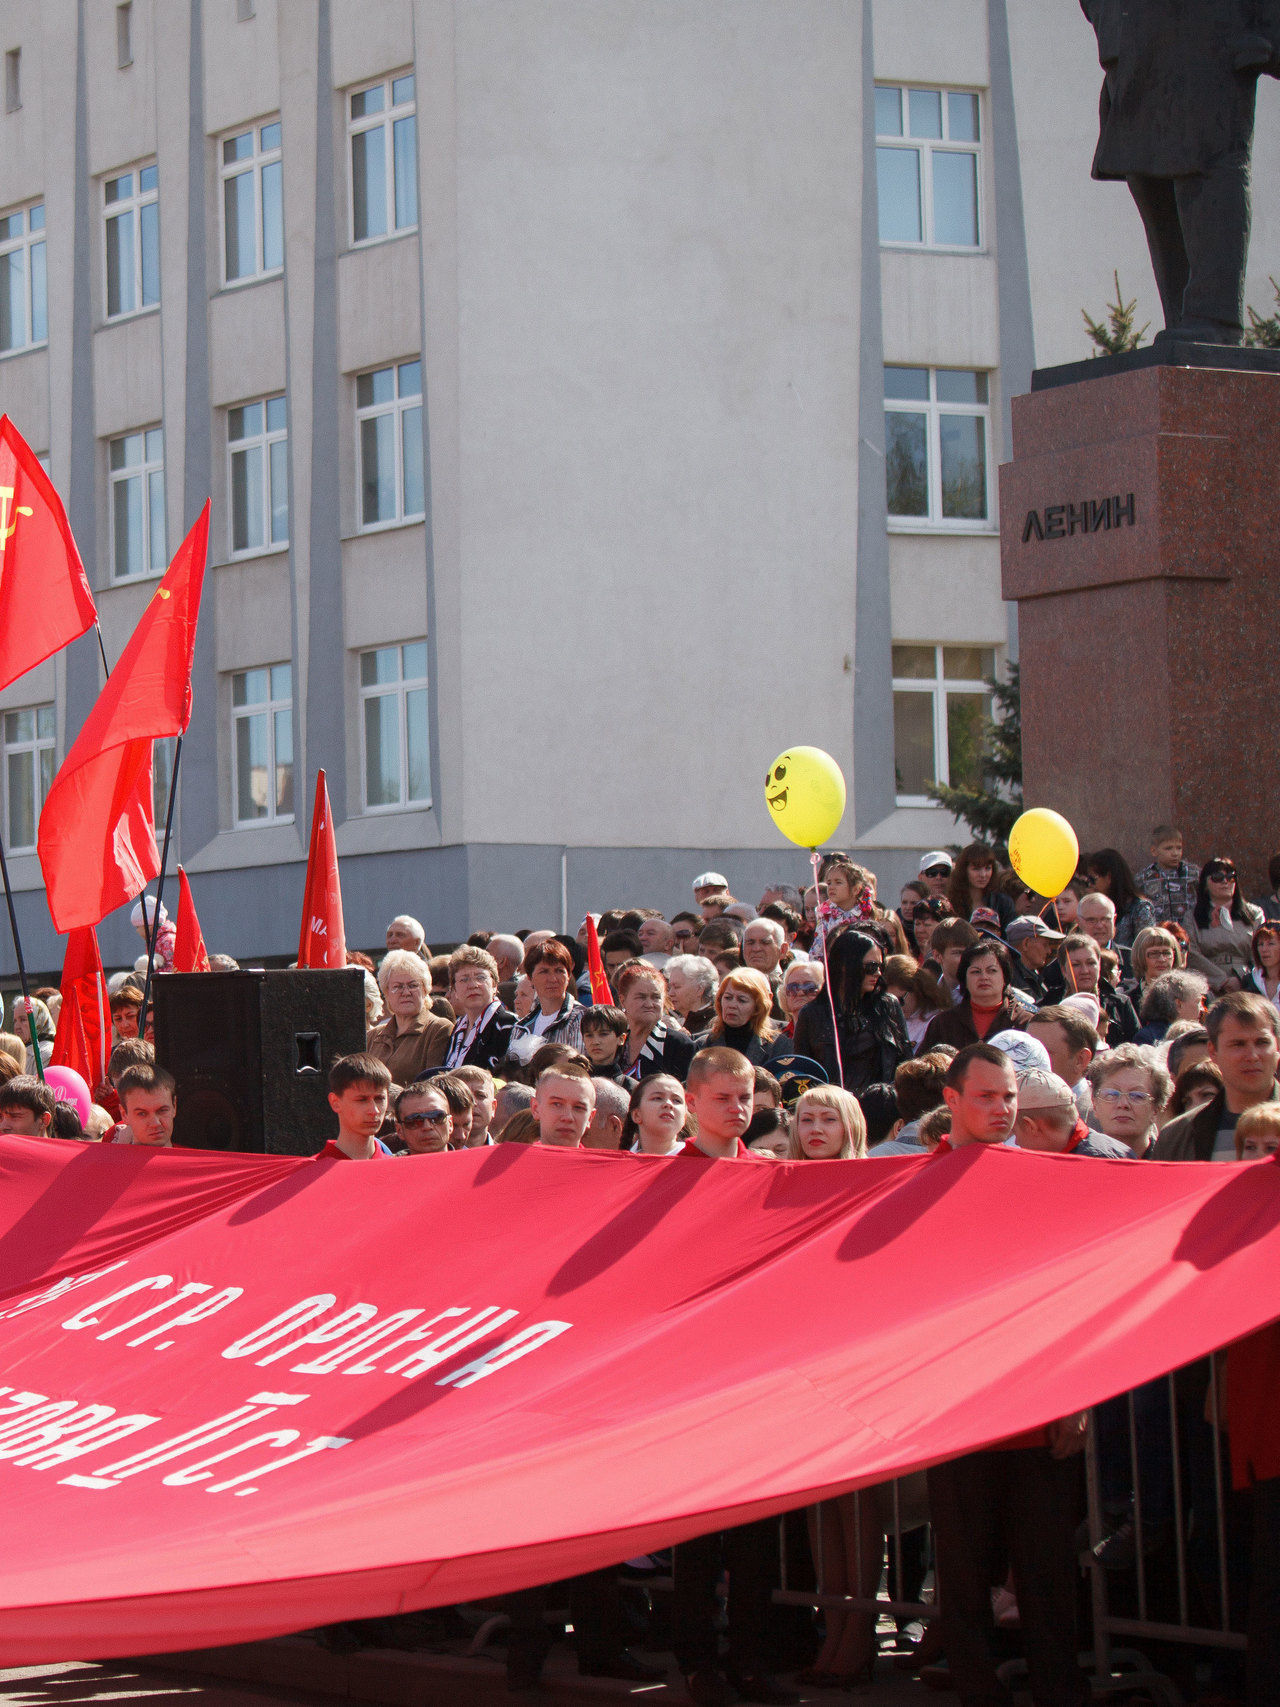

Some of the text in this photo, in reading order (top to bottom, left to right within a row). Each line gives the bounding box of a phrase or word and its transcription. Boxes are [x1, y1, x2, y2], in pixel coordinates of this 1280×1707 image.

[1021, 493, 1136, 543] ЛЕНИН
[61, 1274, 244, 1351] СТР.
[221, 1293, 574, 1389] ОРДЕНА
